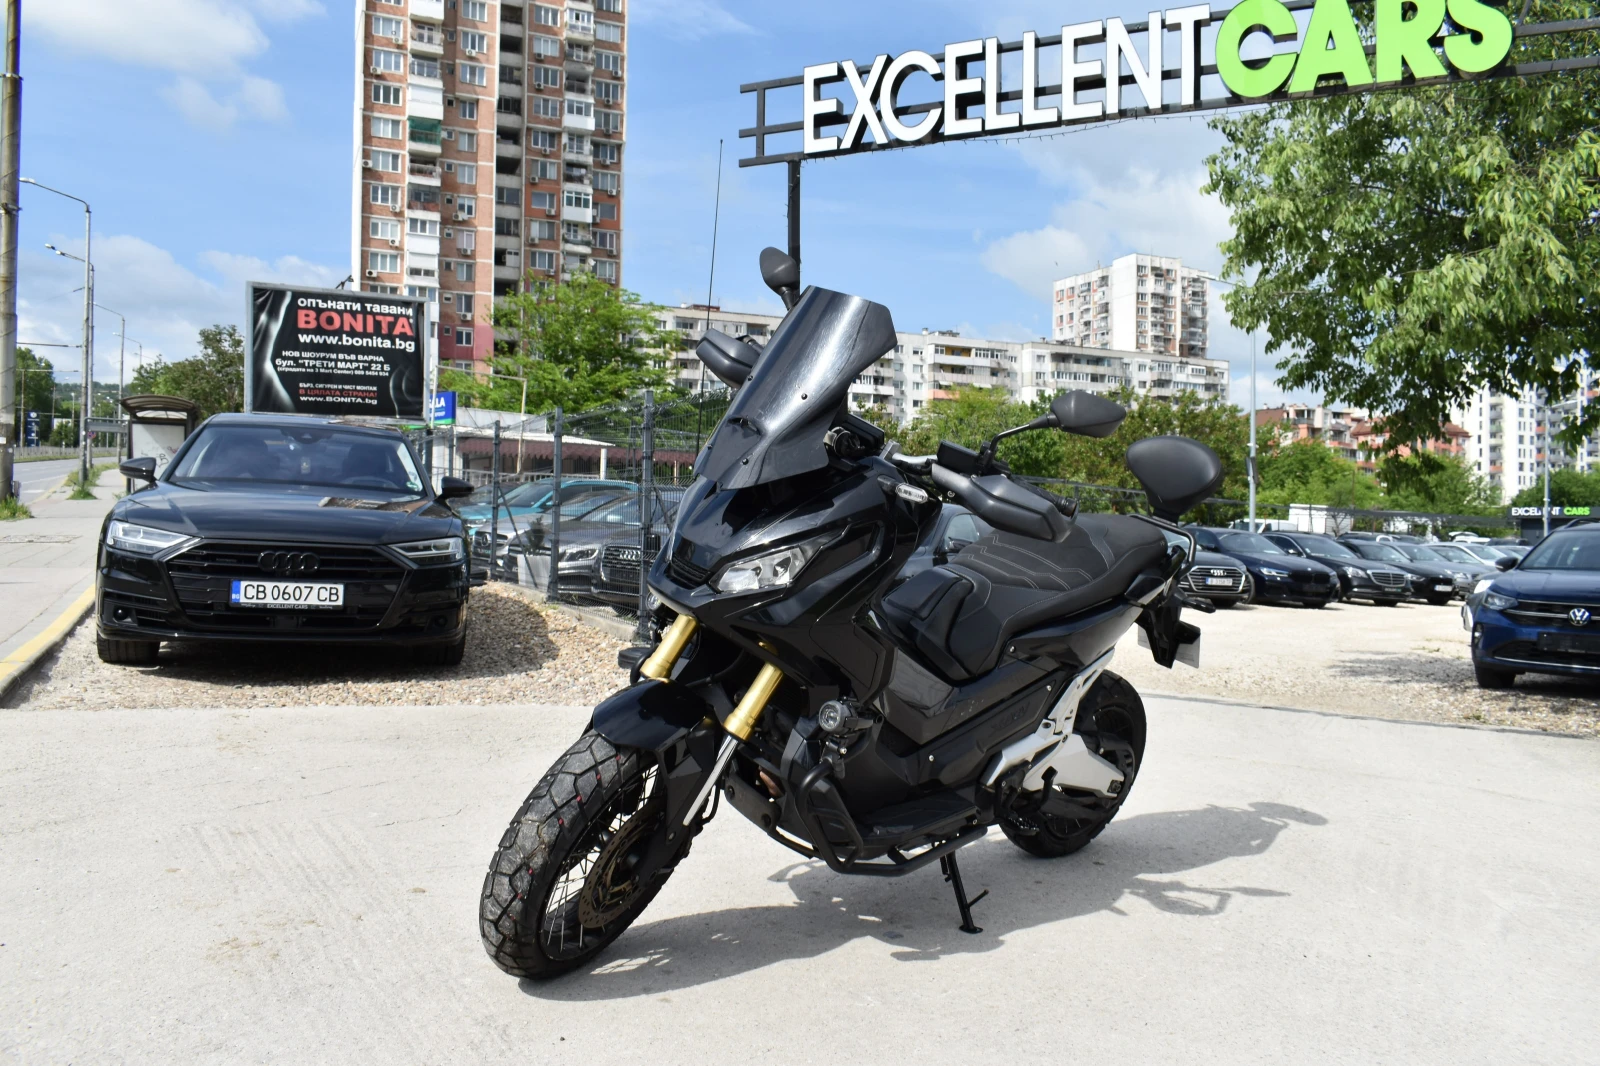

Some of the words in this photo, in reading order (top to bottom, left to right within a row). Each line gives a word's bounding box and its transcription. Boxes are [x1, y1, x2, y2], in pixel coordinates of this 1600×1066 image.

[803, 5, 1211, 154] EXCELLENT
[1215, 0, 1513, 98] CARS
[297, 298, 361, 311] опънати
[365, 303, 413, 316] тавани
[297, 309, 414, 336] BONITA
[298, 333, 416, 352] www.bonita.bg
[275, 358, 296, 367] бул.
[370, 363, 382, 371] 22
[301, 351, 337, 359] ШОУРУМ
[357, 354, 385, 362] ВАРНА
[299, 396, 378, 405] www.BONITA.bg
[1563, 507, 1591, 516] CARS
[244, 584, 267, 600] CB
[271, 585, 314, 601] 0607
[317, 586, 340, 602] CB
